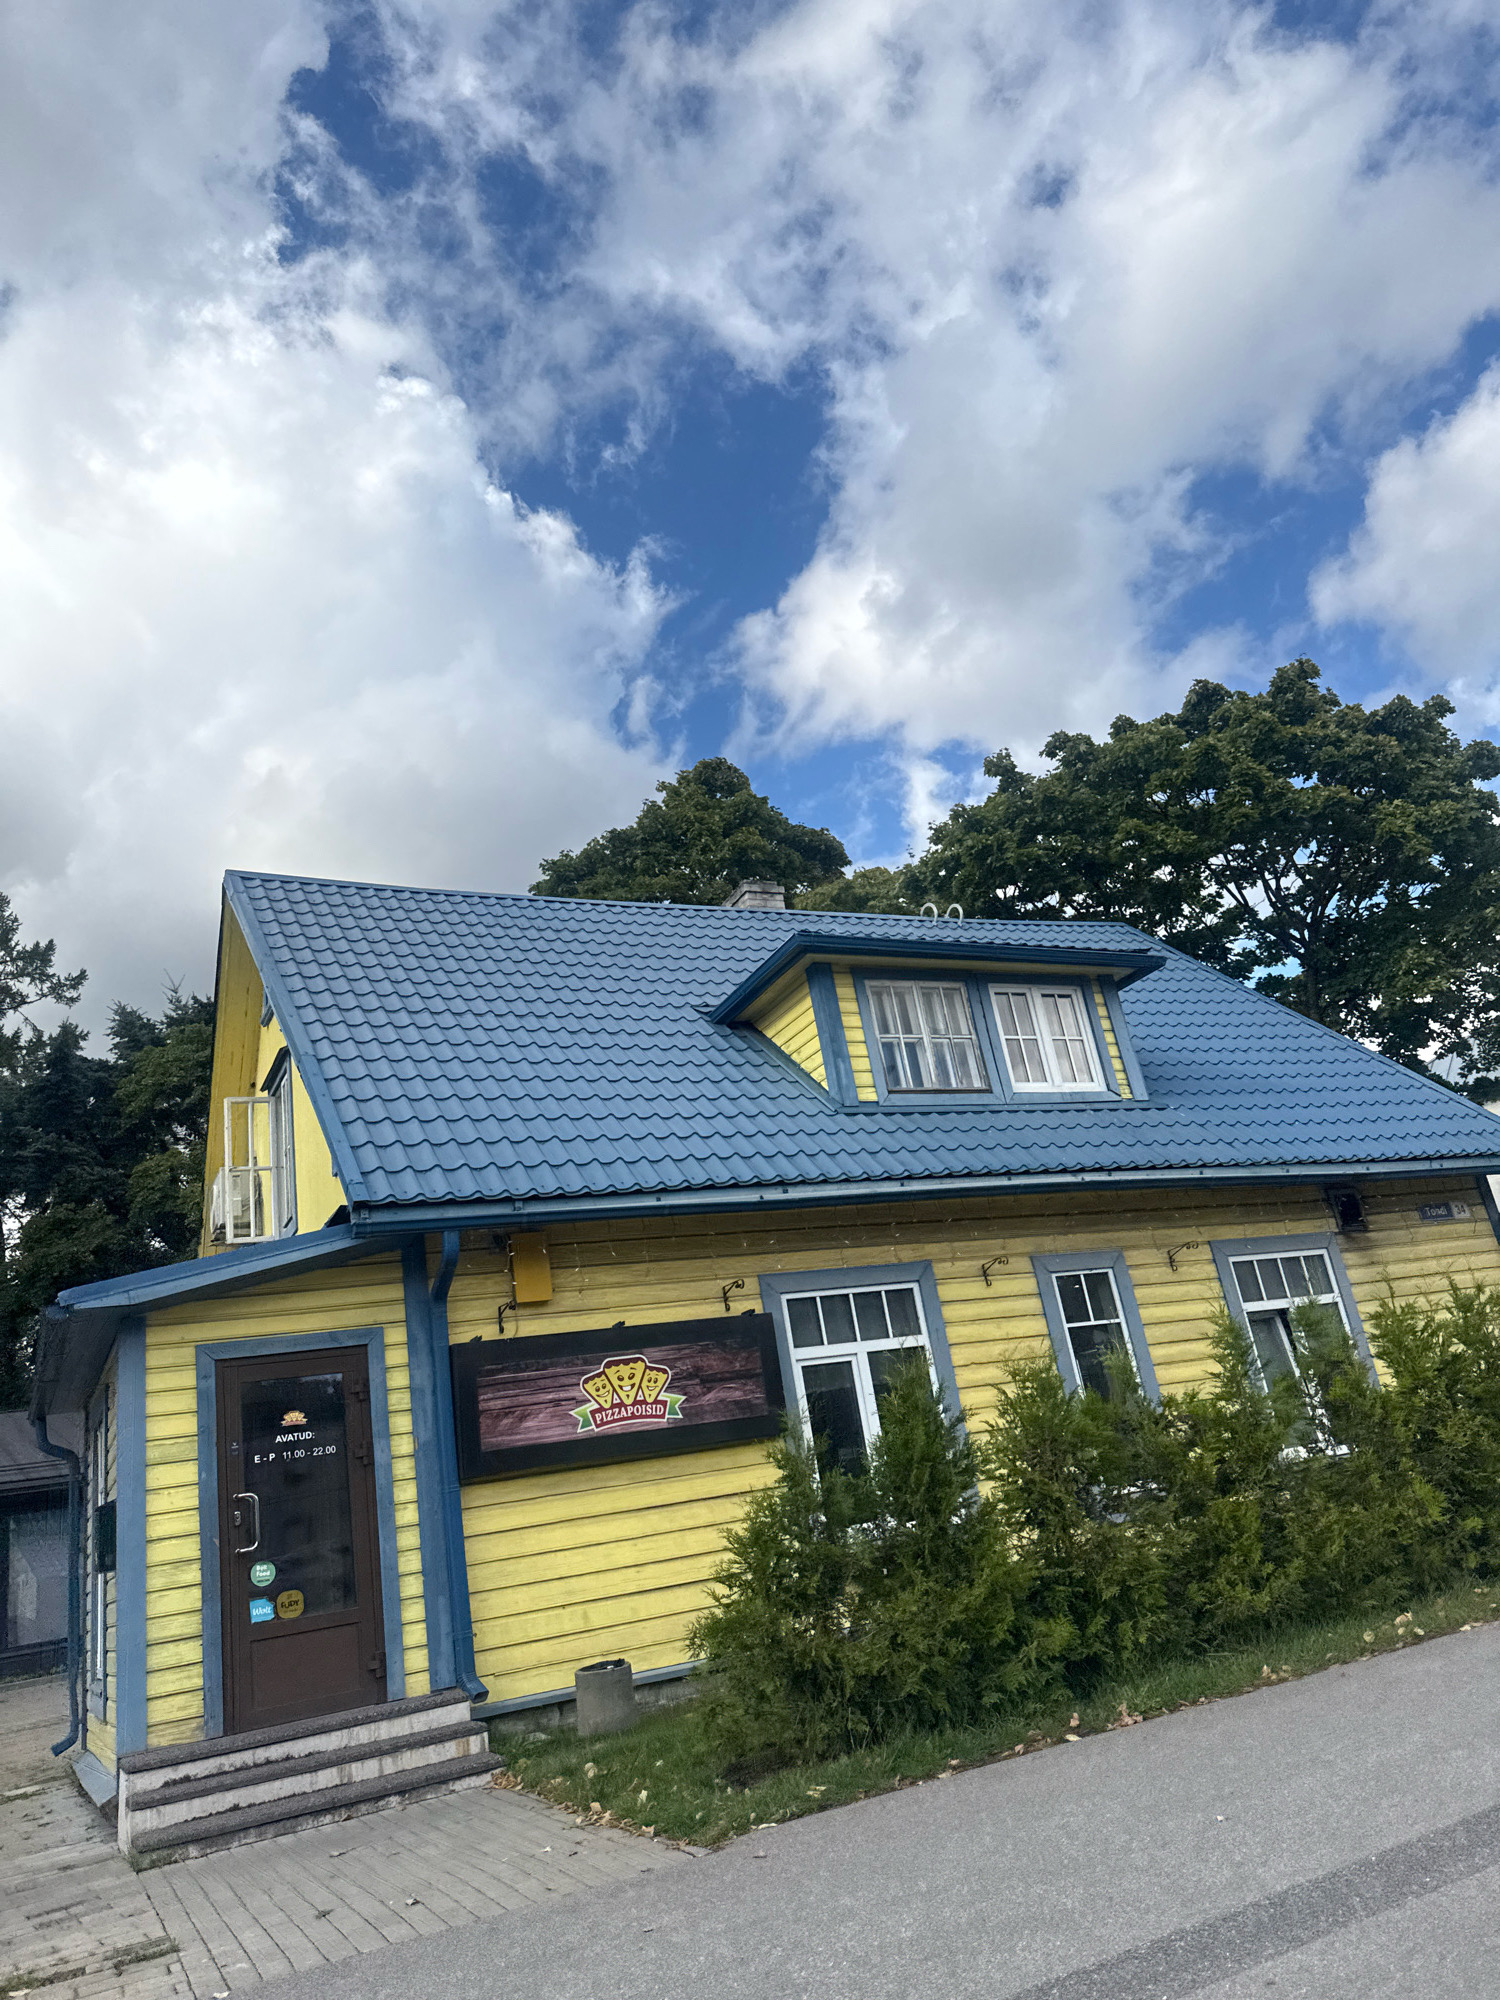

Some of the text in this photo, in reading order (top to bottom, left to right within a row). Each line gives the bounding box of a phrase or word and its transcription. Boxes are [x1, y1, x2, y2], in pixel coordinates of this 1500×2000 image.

[595, 1404, 664, 1424] PIZZAPOISID
[275, 1431, 315, 1443] AVATUD:
[254, 1454, 261, 1463] E
[269, 1453, 276, 1461] P
[282, 1449, 305, 1460] 11.00
[312, 1445, 336, 1456] 22.00
[252, 1606, 271, 1616] Wolt
